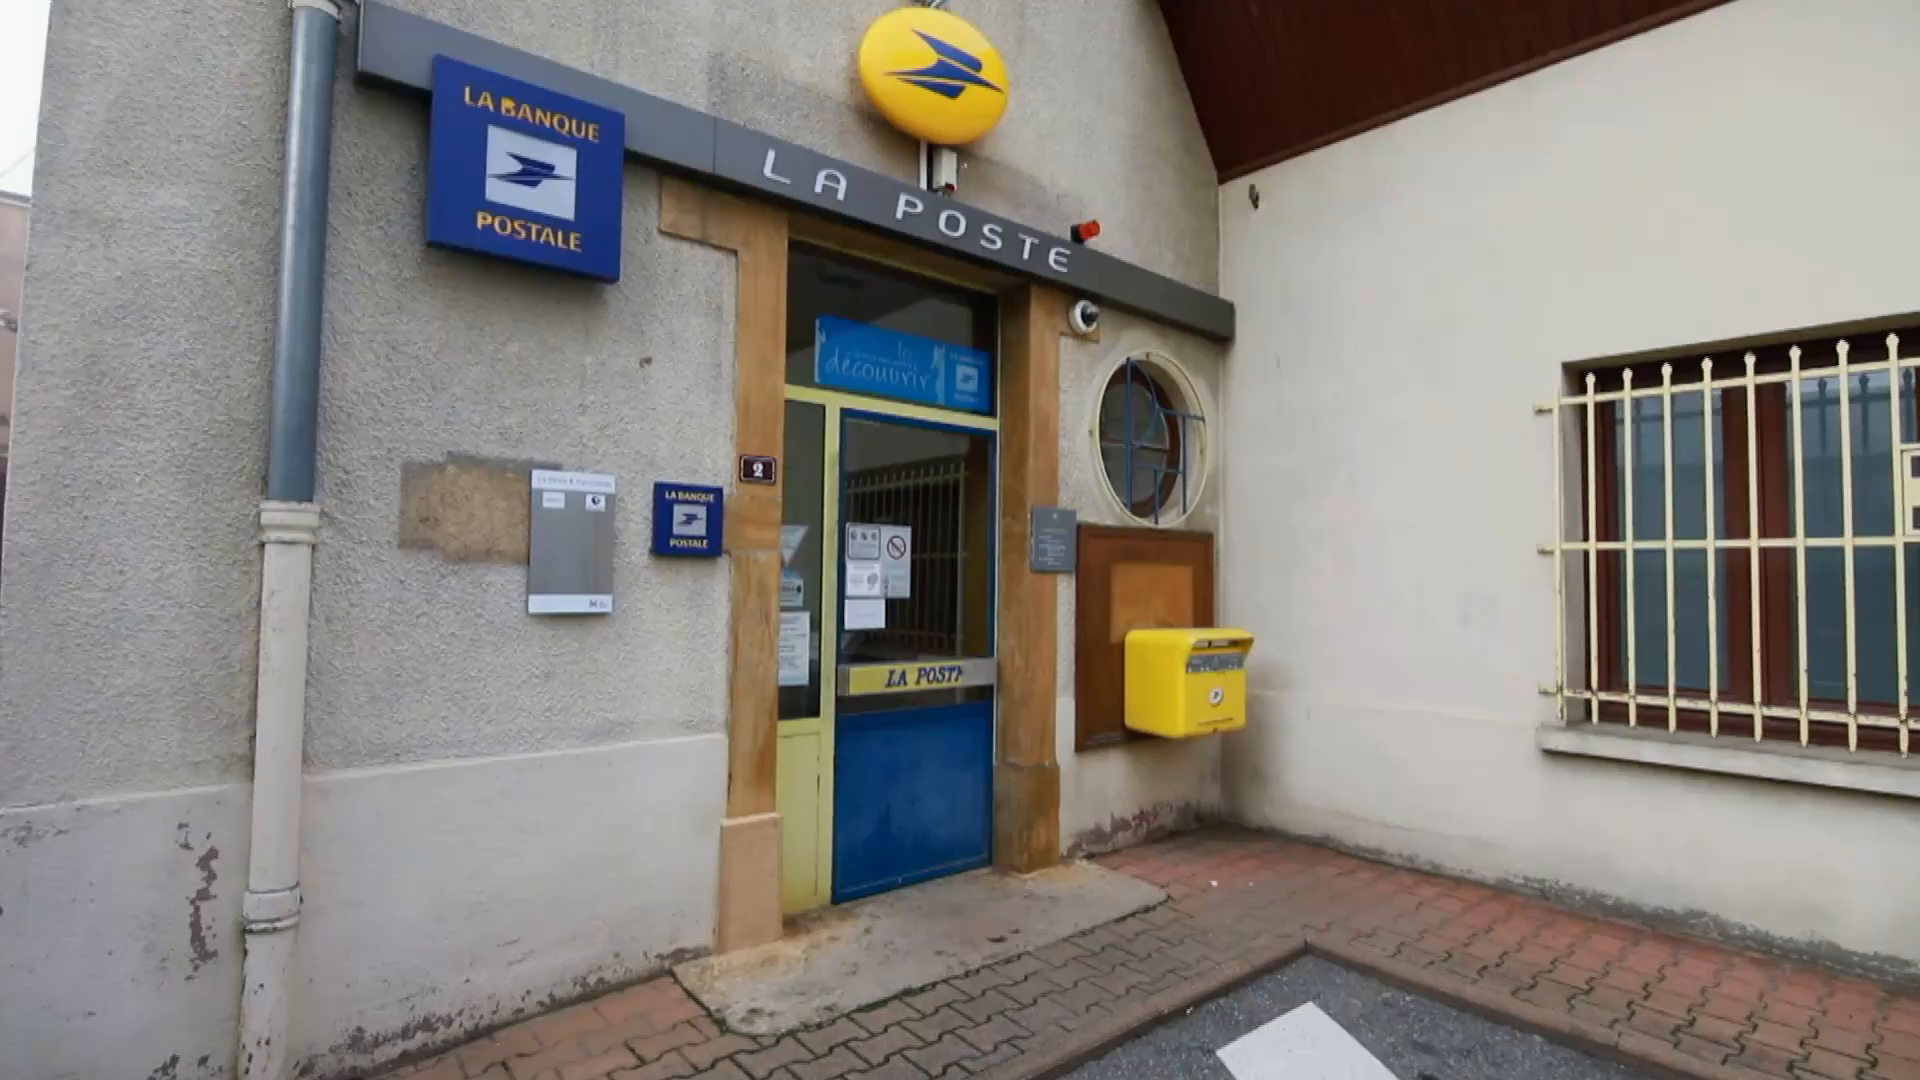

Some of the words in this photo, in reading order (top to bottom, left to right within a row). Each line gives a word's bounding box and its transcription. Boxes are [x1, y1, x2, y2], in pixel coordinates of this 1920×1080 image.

[463, 85, 495, 113] LA
[500, 96, 600, 144] BANQUE
[762, 147, 848, 201] LA
[895, 192, 1072, 273] POSTE
[476, 210, 583, 253] POSTALE
[752, 461, 765, 478] 2
[664, 489, 676, 501] LA
[678, 491, 715, 504] BANQUE
[669, 537, 709, 549] POSTALE
[884, 668, 909, 689] LA
